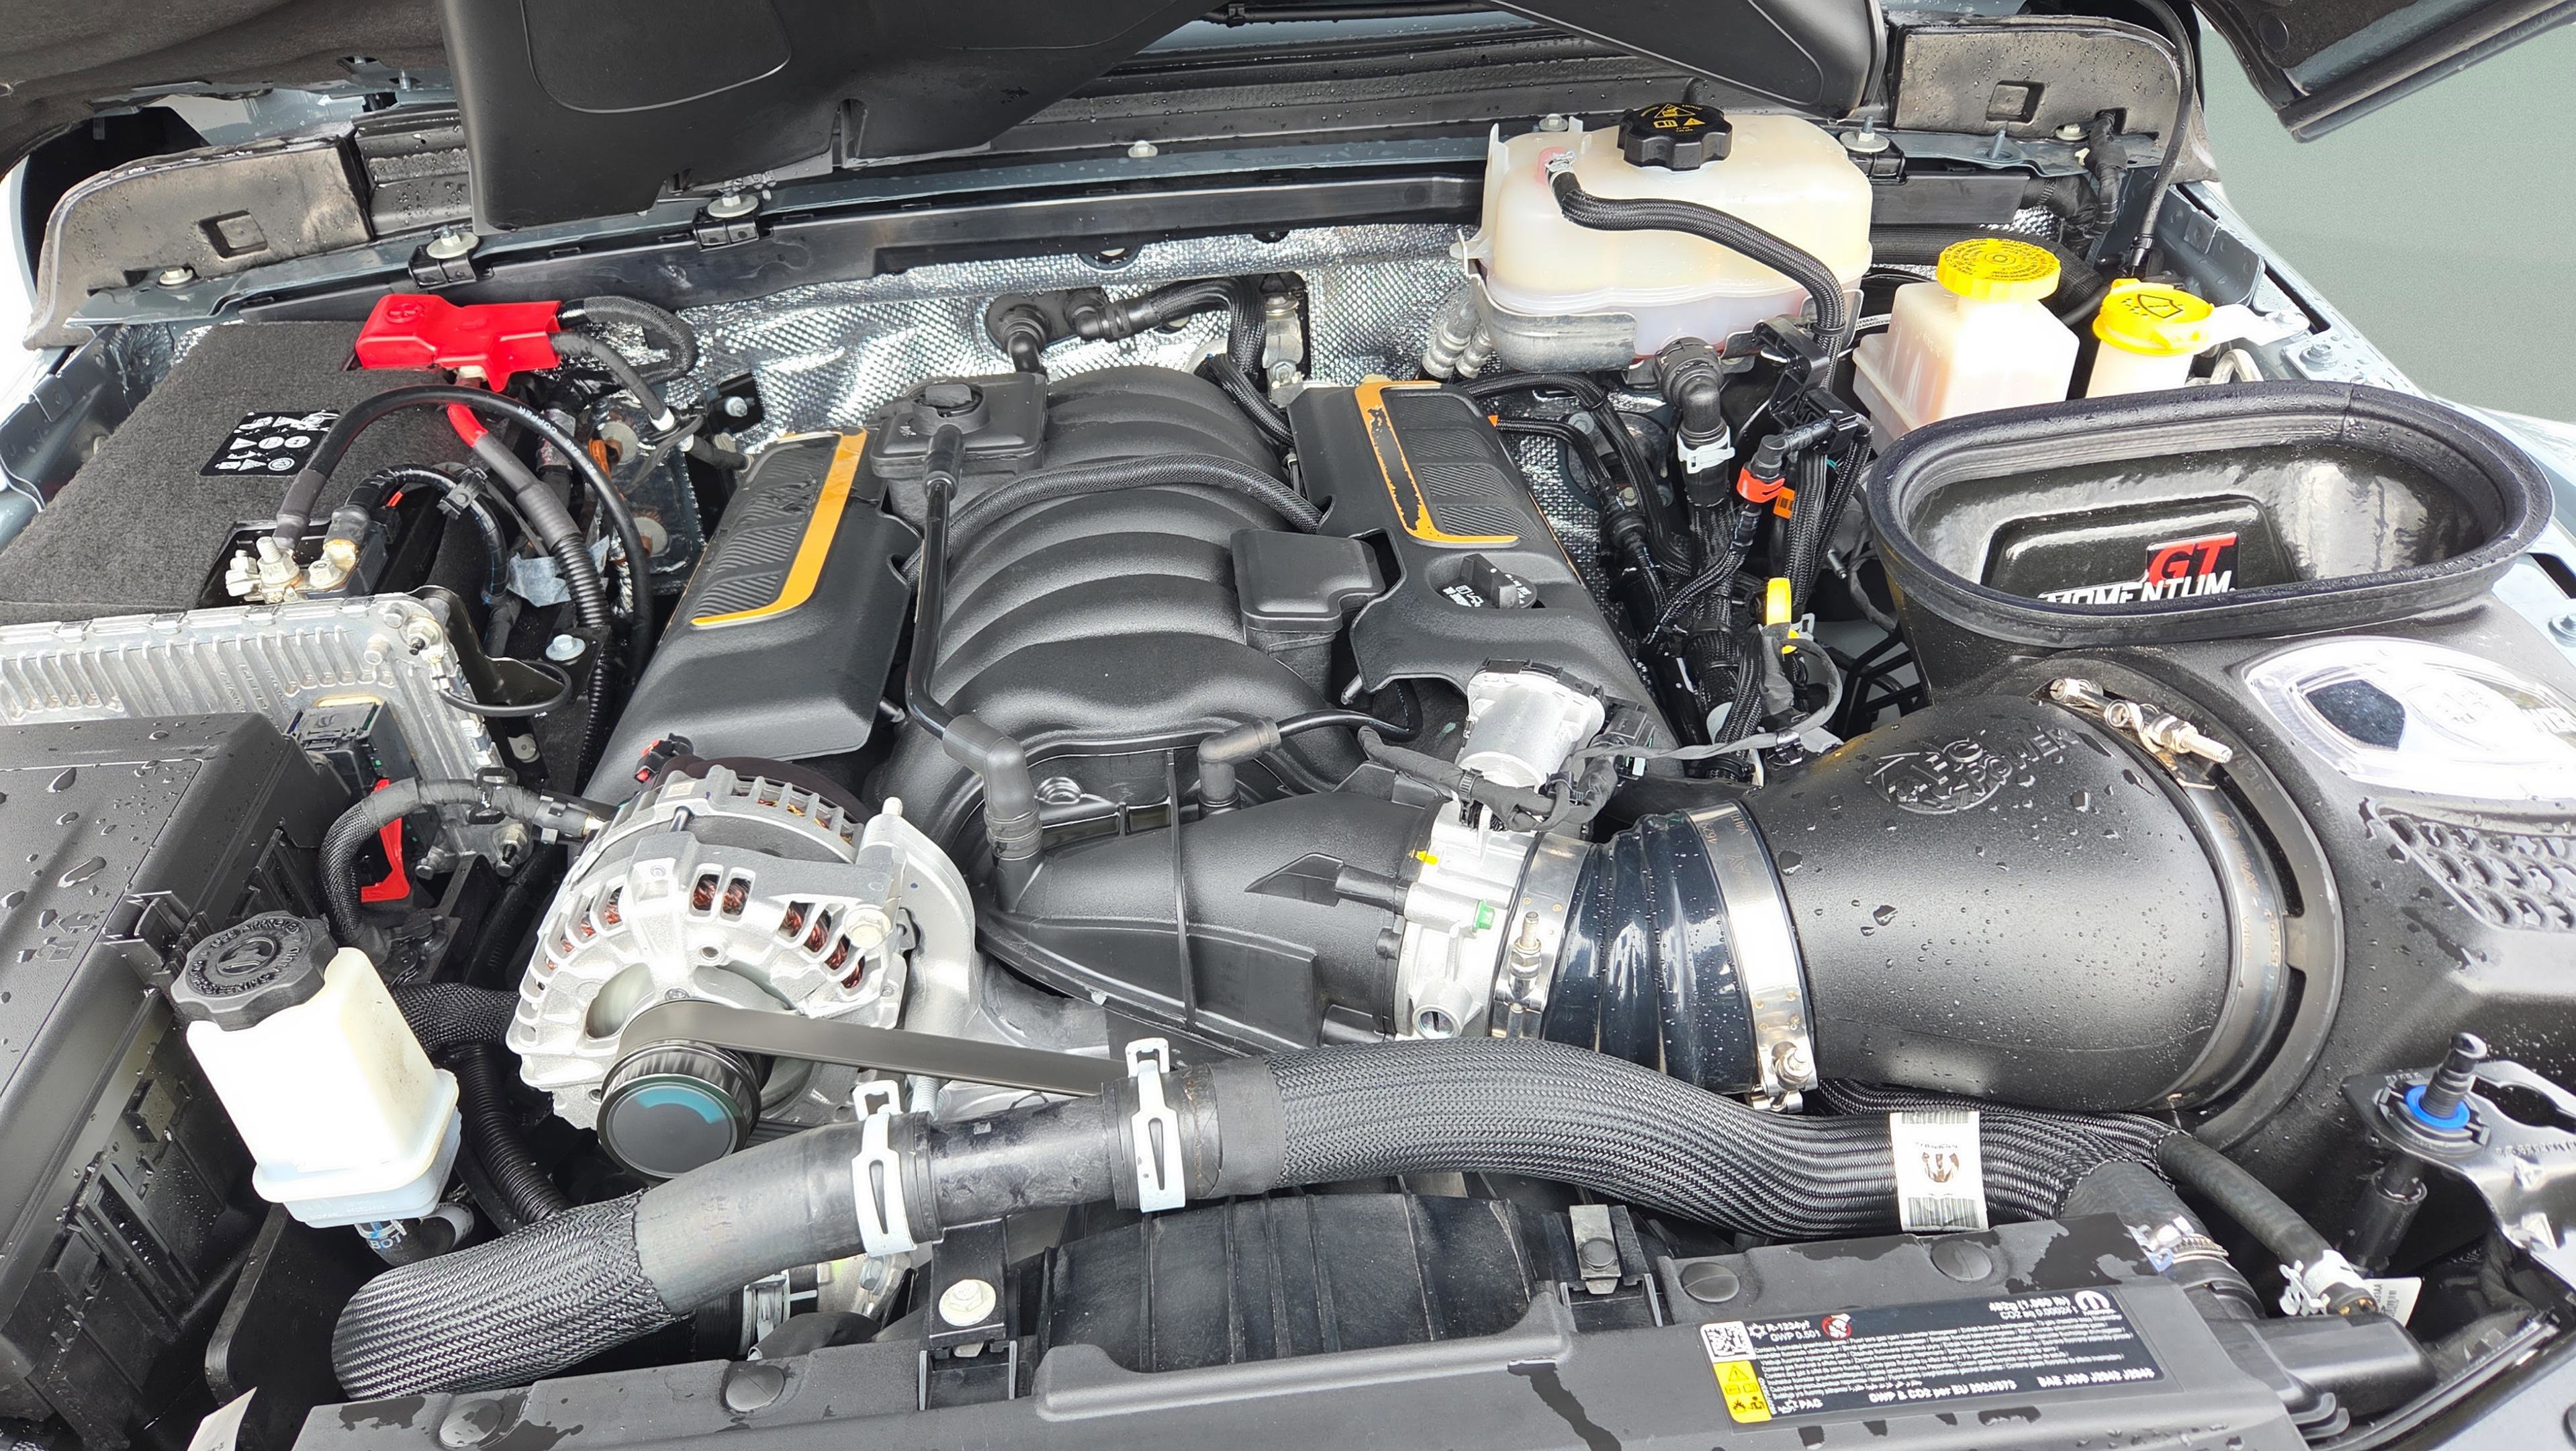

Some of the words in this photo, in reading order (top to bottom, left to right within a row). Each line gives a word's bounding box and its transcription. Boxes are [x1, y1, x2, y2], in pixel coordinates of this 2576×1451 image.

[517, 404, 559, 435] COPPER
[563, 437, 582, 457] SAE
[2148, 535, 2238, 588] GT
[211, 928, 238, 949] USE
[240, 918, 300, 934] APPROVED
[272, 947, 301, 973] FLUID
[2000, 1310, 2023, 1321] CO2
[1765, 1320, 1811, 1333] R-1234yf
[1770, 1331, 1795, 1342] GWP
[1795, 1329, 1821, 1340] 0.501
[1868, 1391, 1896, 1403] GWP
[1907, 1387, 1933, 1399] CO2
[1950, 1383, 1970, 1395] EU
[1798, 1398, 1824, 1410] PAG
